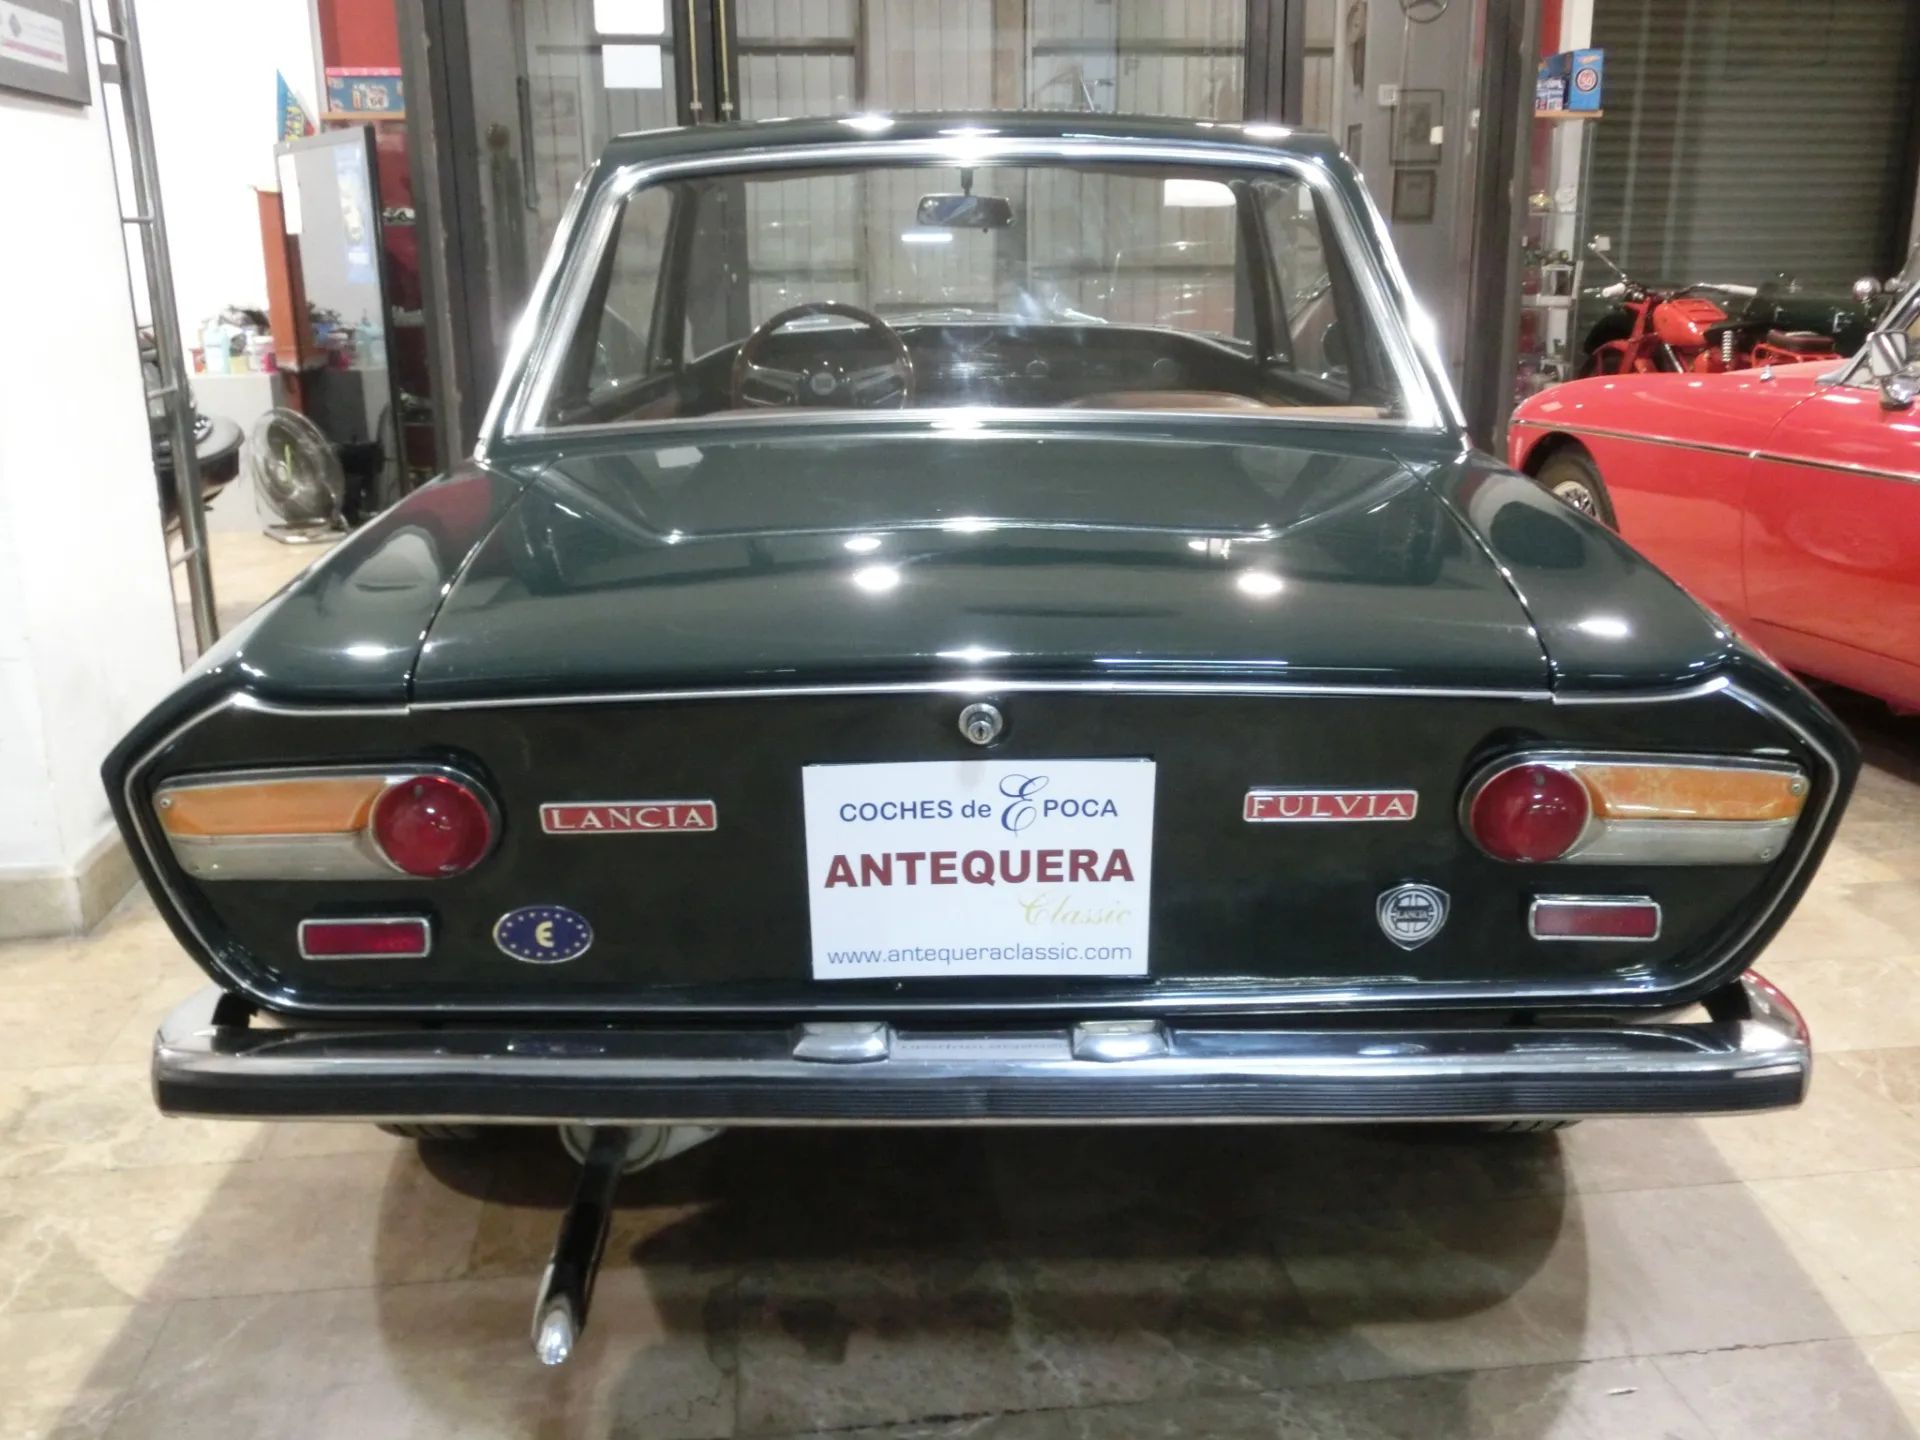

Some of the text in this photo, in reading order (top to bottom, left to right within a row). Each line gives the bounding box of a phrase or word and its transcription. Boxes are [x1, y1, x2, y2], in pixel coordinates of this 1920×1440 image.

[839, 800, 953, 823] COCHES
[961, 800, 992, 818] de
[1252, 796, 1408, 817] FULVIA
[552, 808, 706, 829] LANCIA
[824, 848, 1134, 888] ANTEQUERA
[1018, 891, 1133, 927] Classic
[827, 942, 1132, 965] www.antequeraclassic.com
